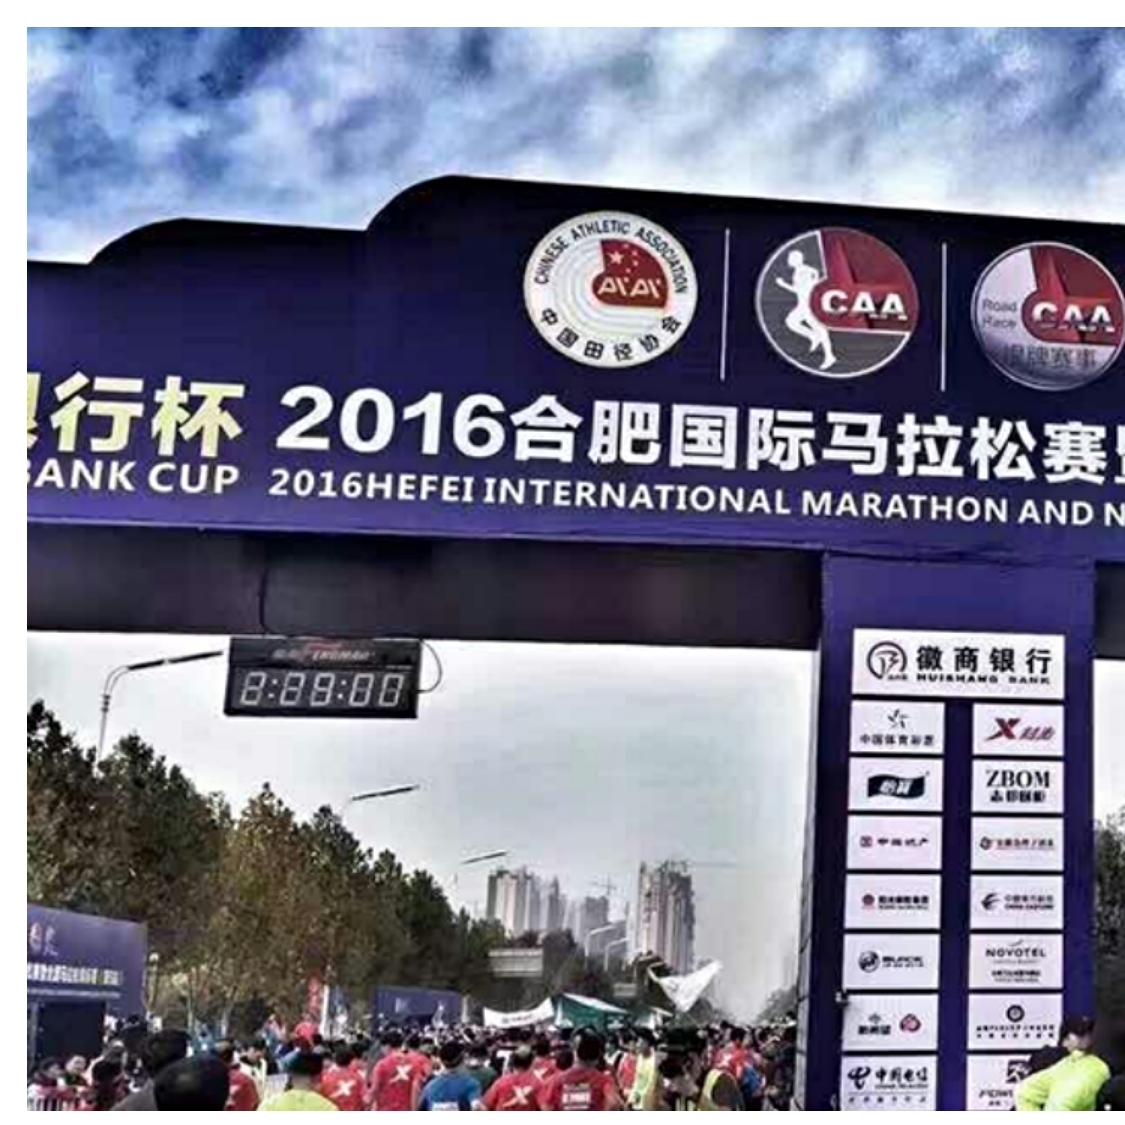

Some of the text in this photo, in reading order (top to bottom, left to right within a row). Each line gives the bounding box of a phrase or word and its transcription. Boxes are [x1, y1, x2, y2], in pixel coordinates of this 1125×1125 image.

[534, 235, 570, 285] CHINESE
[571, 219, 630, 241] ATHLETIC
[633, 226, 689, 294] ASSOCIATION
[821, 289, 907, 318] CAA
[1031, 301, 1115, 333] CAA
[540, 306, 682, 362] 中国田径协会
[147, 462, 240, 494] CUP
[268, 469, 473, 502] 2016HEFEI
[484, 477, 791, 516] INTERNATIONAL
[802, 490, 1007, 523] MARATHON
[1018, 498, 1094, 527] AND
[916, 645, 1053, 675] 徽商银行
[986, 769, 1050, 788] ZBOM
[985, 947, 1046, 958] NOVOTEL
